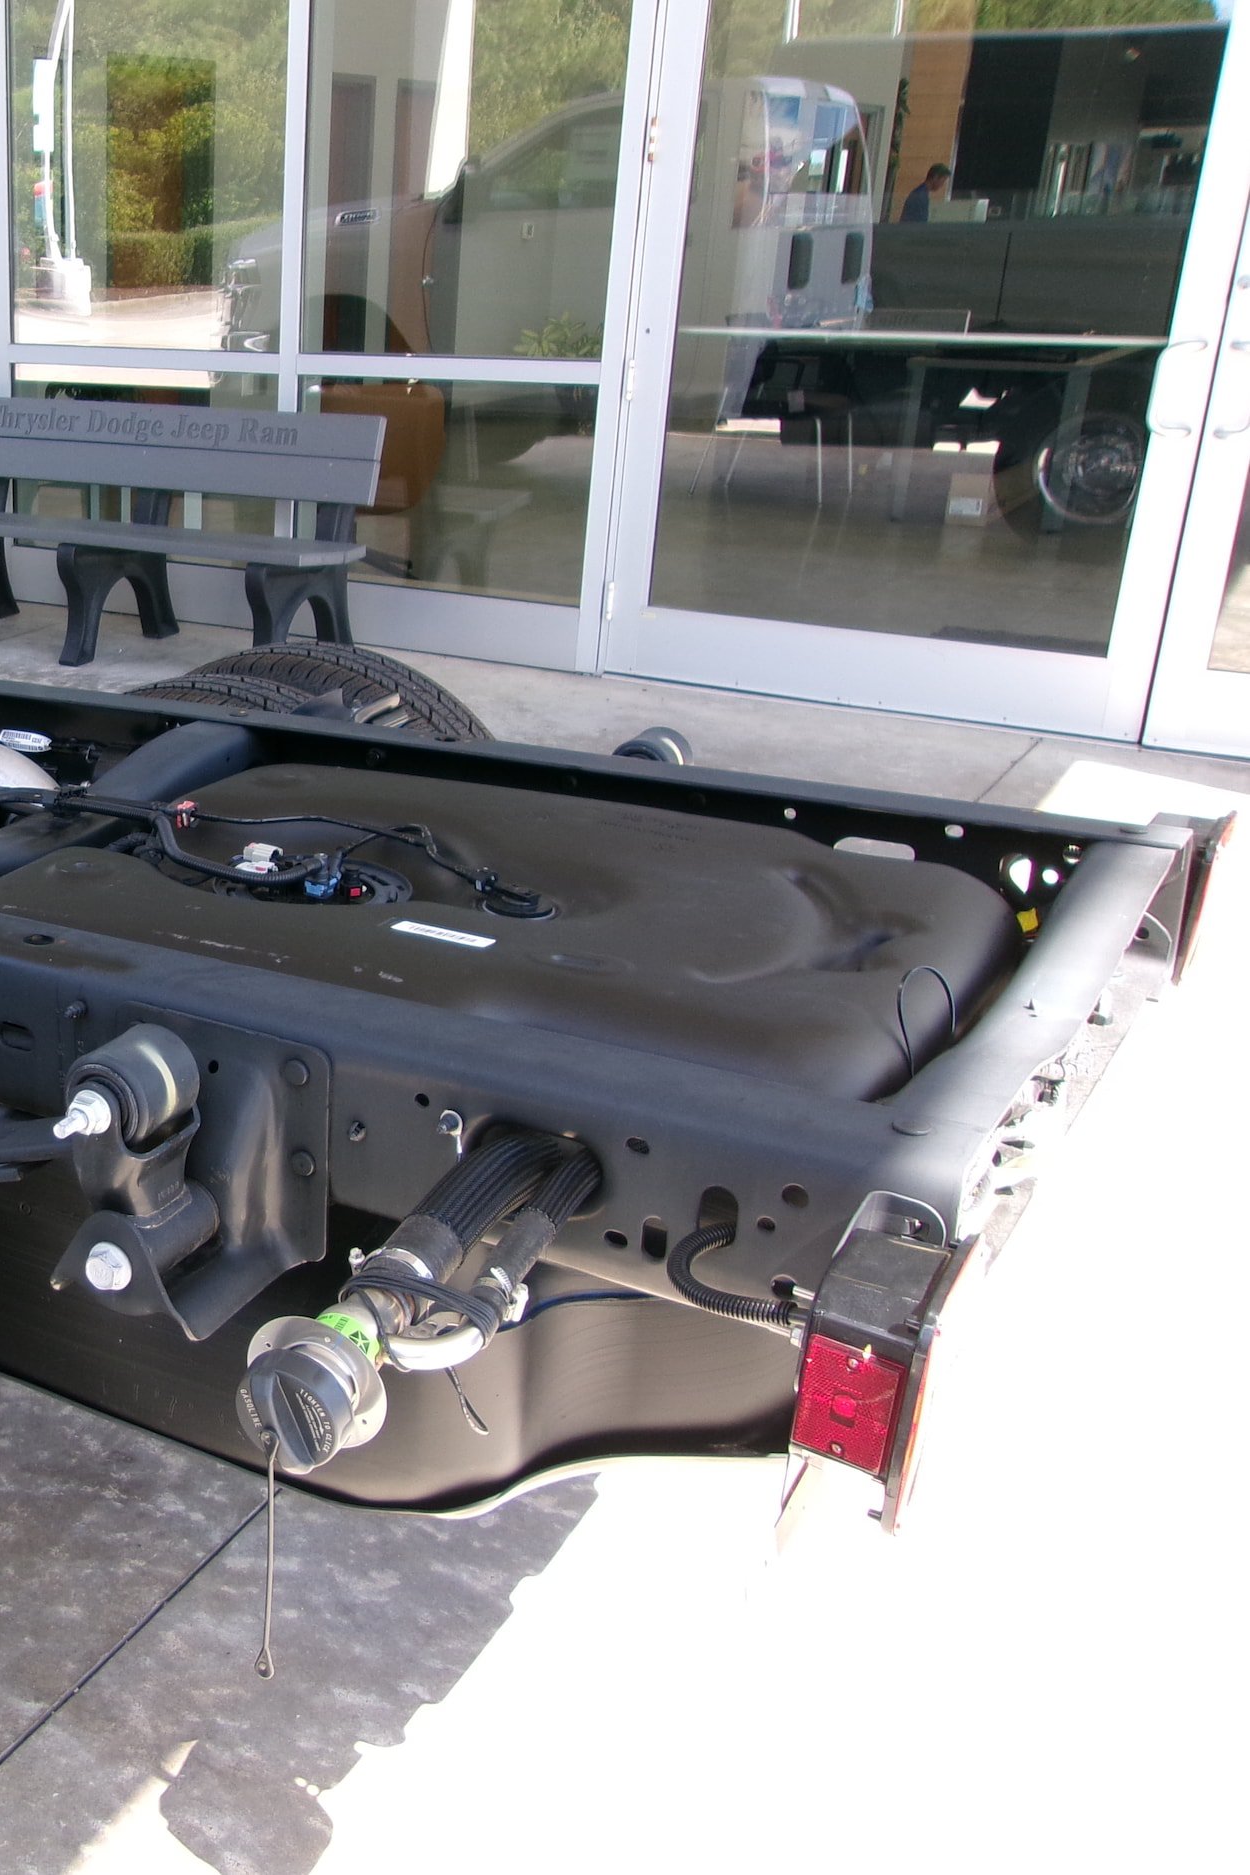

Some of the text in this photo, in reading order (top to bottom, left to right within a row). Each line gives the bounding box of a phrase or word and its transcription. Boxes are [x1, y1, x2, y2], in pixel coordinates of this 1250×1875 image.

[87, 408, 165, 443] Dodge
[171, 413, 230, 447] Jeep
[238, 417, 299, 447] Ram
[239, 1387, 263, 1429] GASOLINE
[299, 1387, 326, 1418] TIGHTEN
[323, 1421, 332, 1431] TO
[322, 1432, 333, 1454] CLICK
